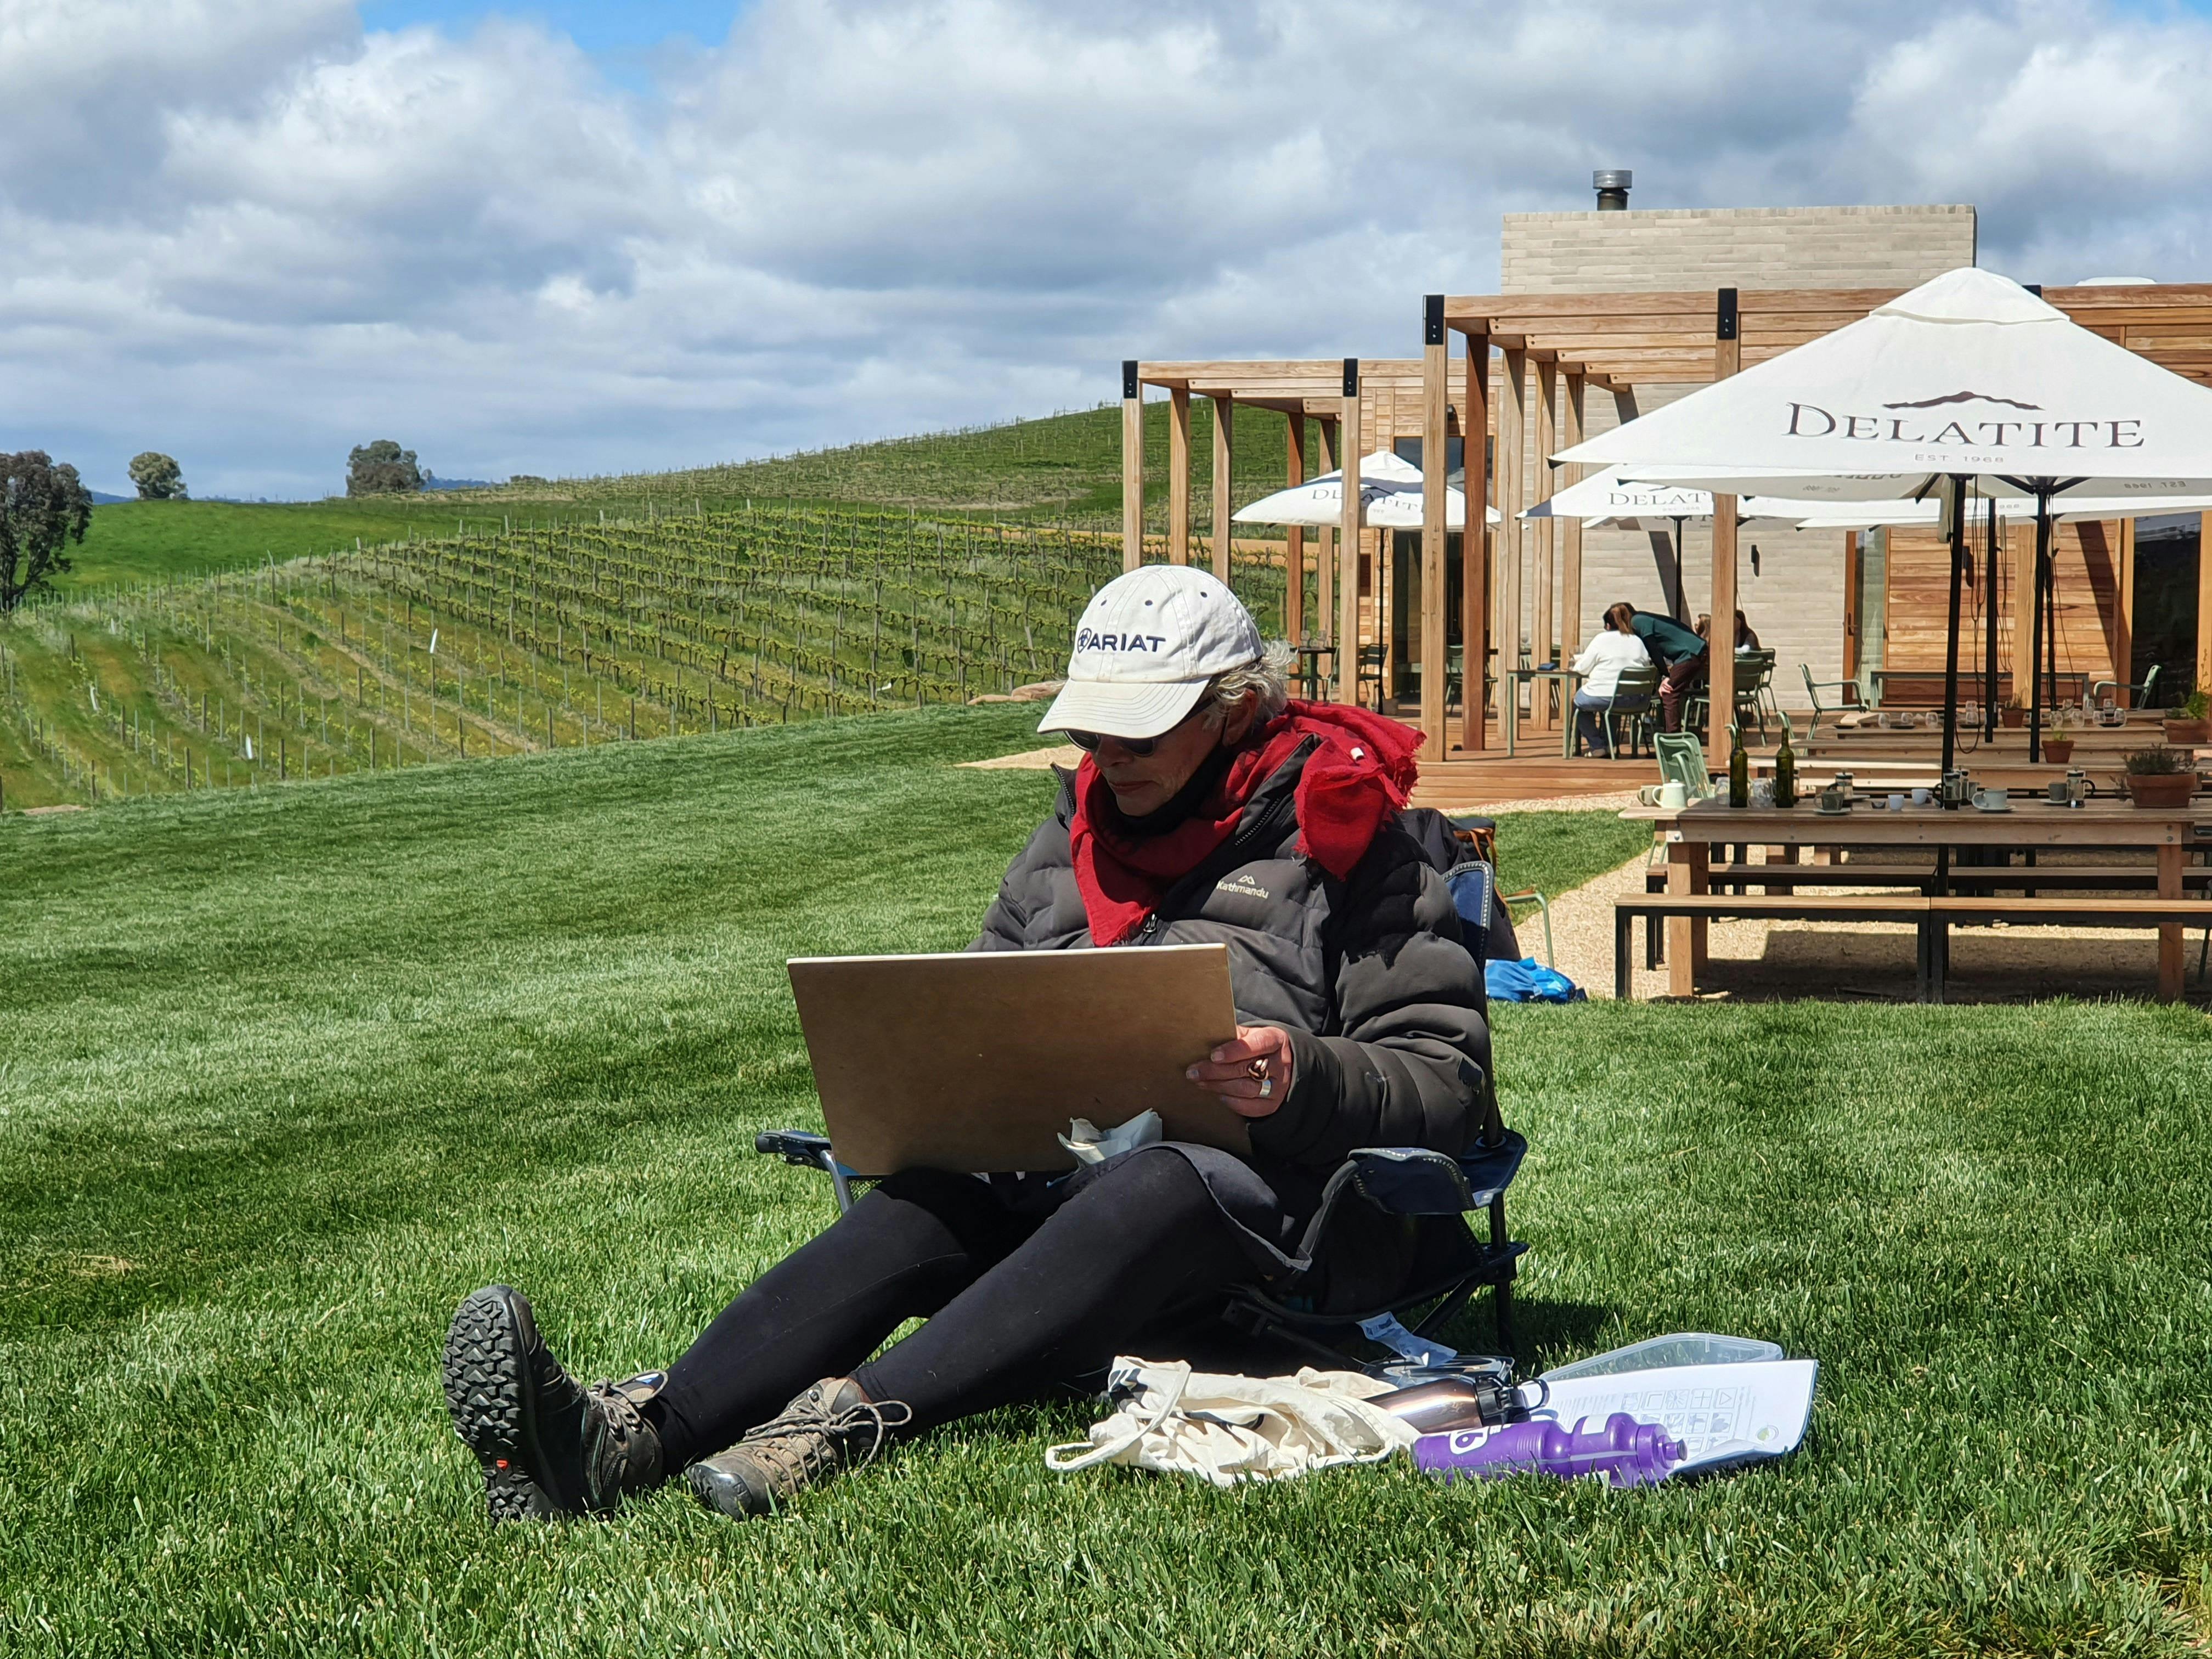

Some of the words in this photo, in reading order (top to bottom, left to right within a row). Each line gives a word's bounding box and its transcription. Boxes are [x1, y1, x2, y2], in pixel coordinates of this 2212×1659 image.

[1782, 402, 2145, 448] DELATITE
[1608, 492, 1706, 505] DELAT
[1087, 633, 1166, 653] ARIAT
[1216, 880, 1269, 900] Kathmandu
